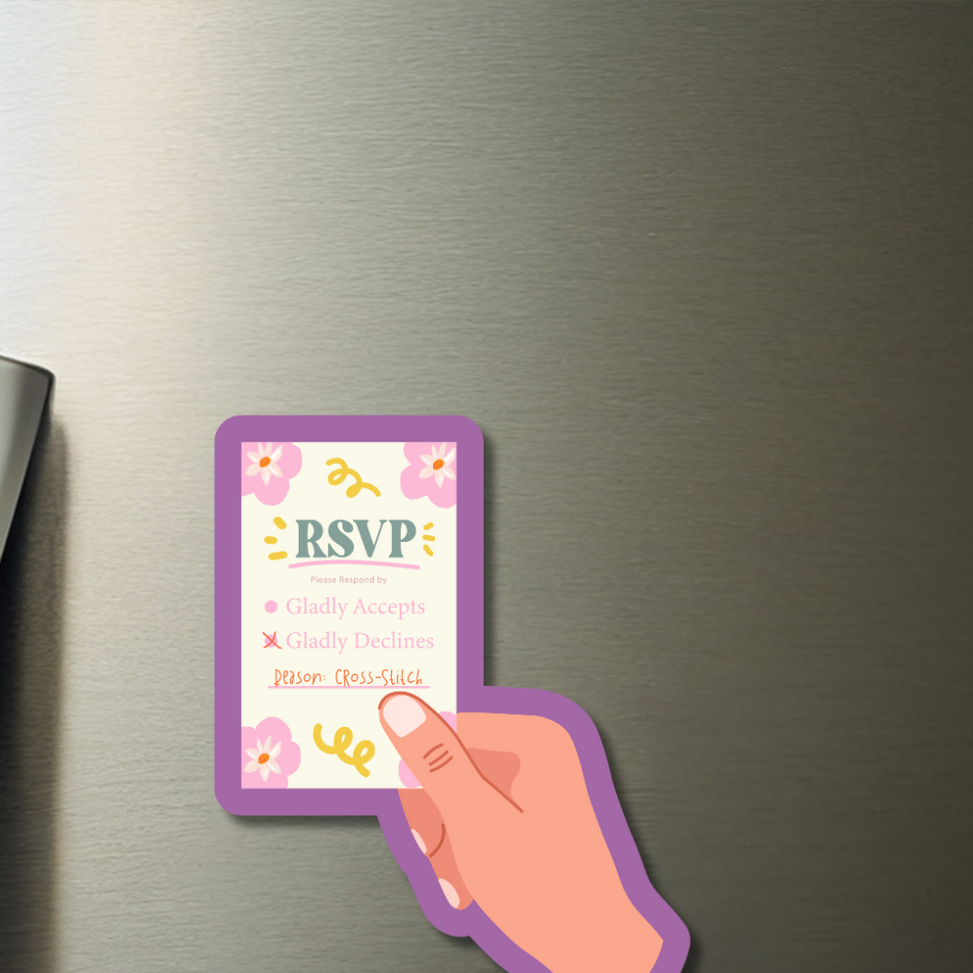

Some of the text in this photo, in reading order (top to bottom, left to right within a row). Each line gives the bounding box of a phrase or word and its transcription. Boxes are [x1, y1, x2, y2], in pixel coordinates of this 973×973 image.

[295, 519, 417, 558] RSVP
[310, 575, 388, 585] Please Respond by
[285, 596, 426, 620] Gladly Accepts
[285, 631, 434, 655] Gladly Declines
